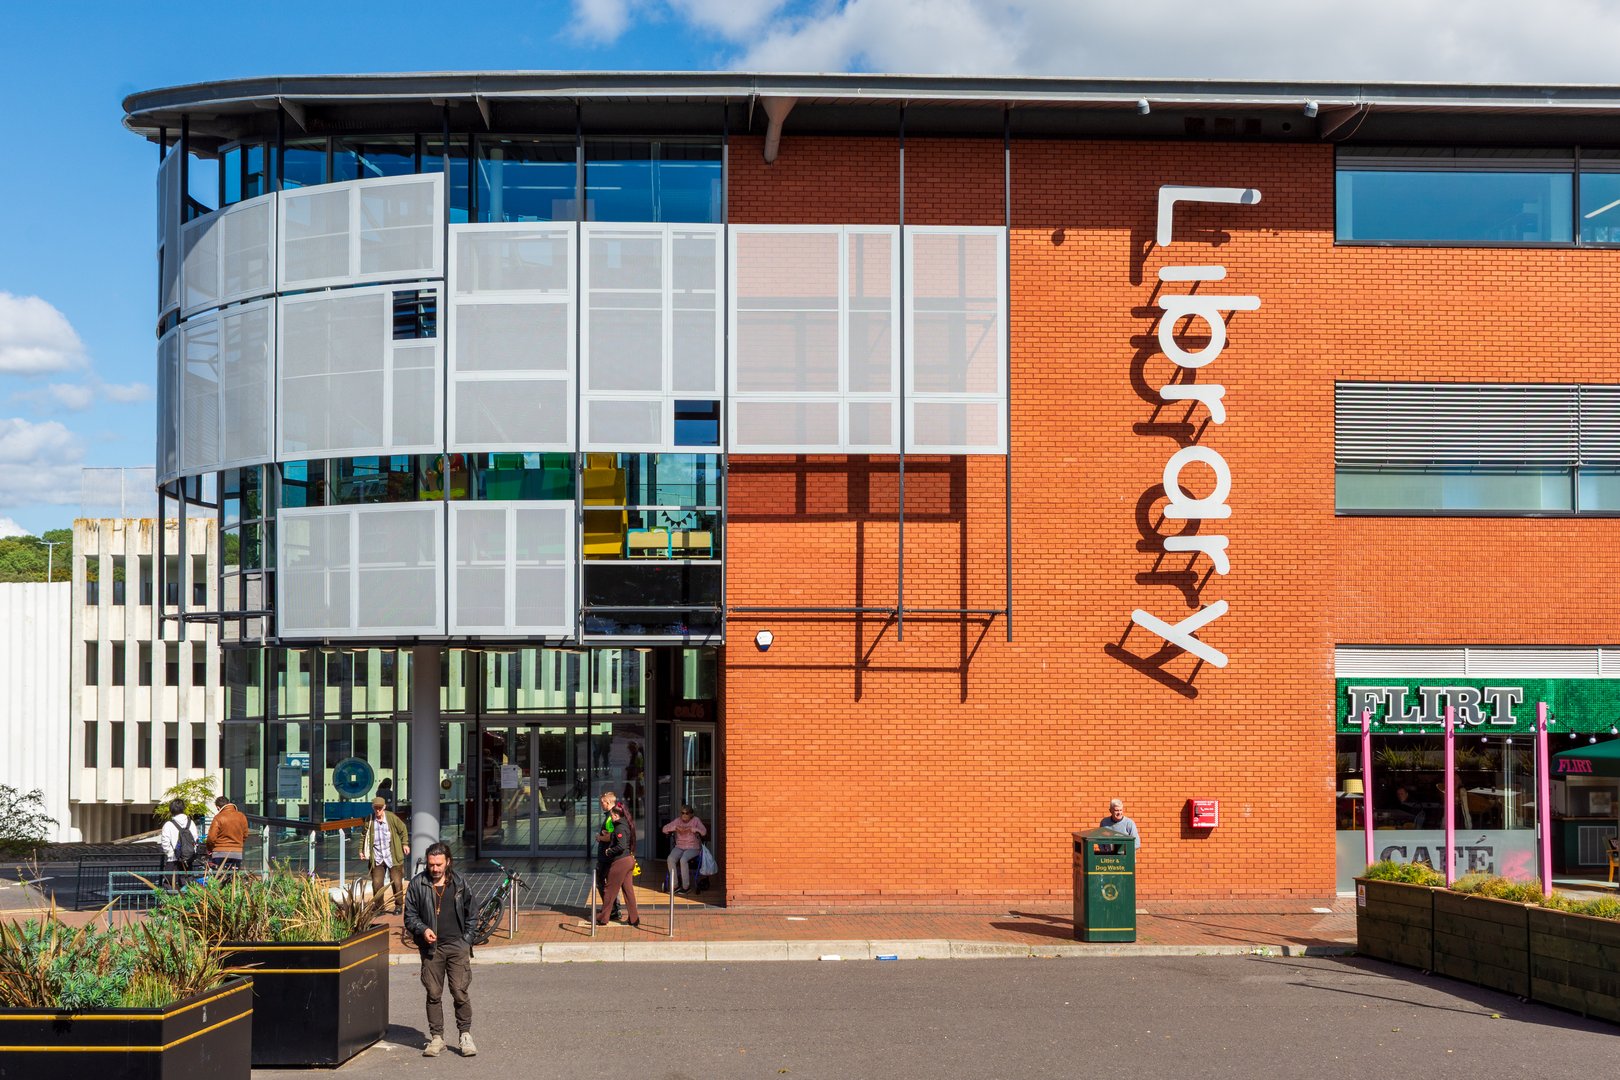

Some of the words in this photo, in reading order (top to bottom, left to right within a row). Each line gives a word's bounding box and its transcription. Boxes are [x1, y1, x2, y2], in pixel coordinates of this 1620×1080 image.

[1131, 184, 1262, 668] Library
[1348, 686, 1523, 725] FLIRT
[1557, 758, 1593, 773] FLIRT
